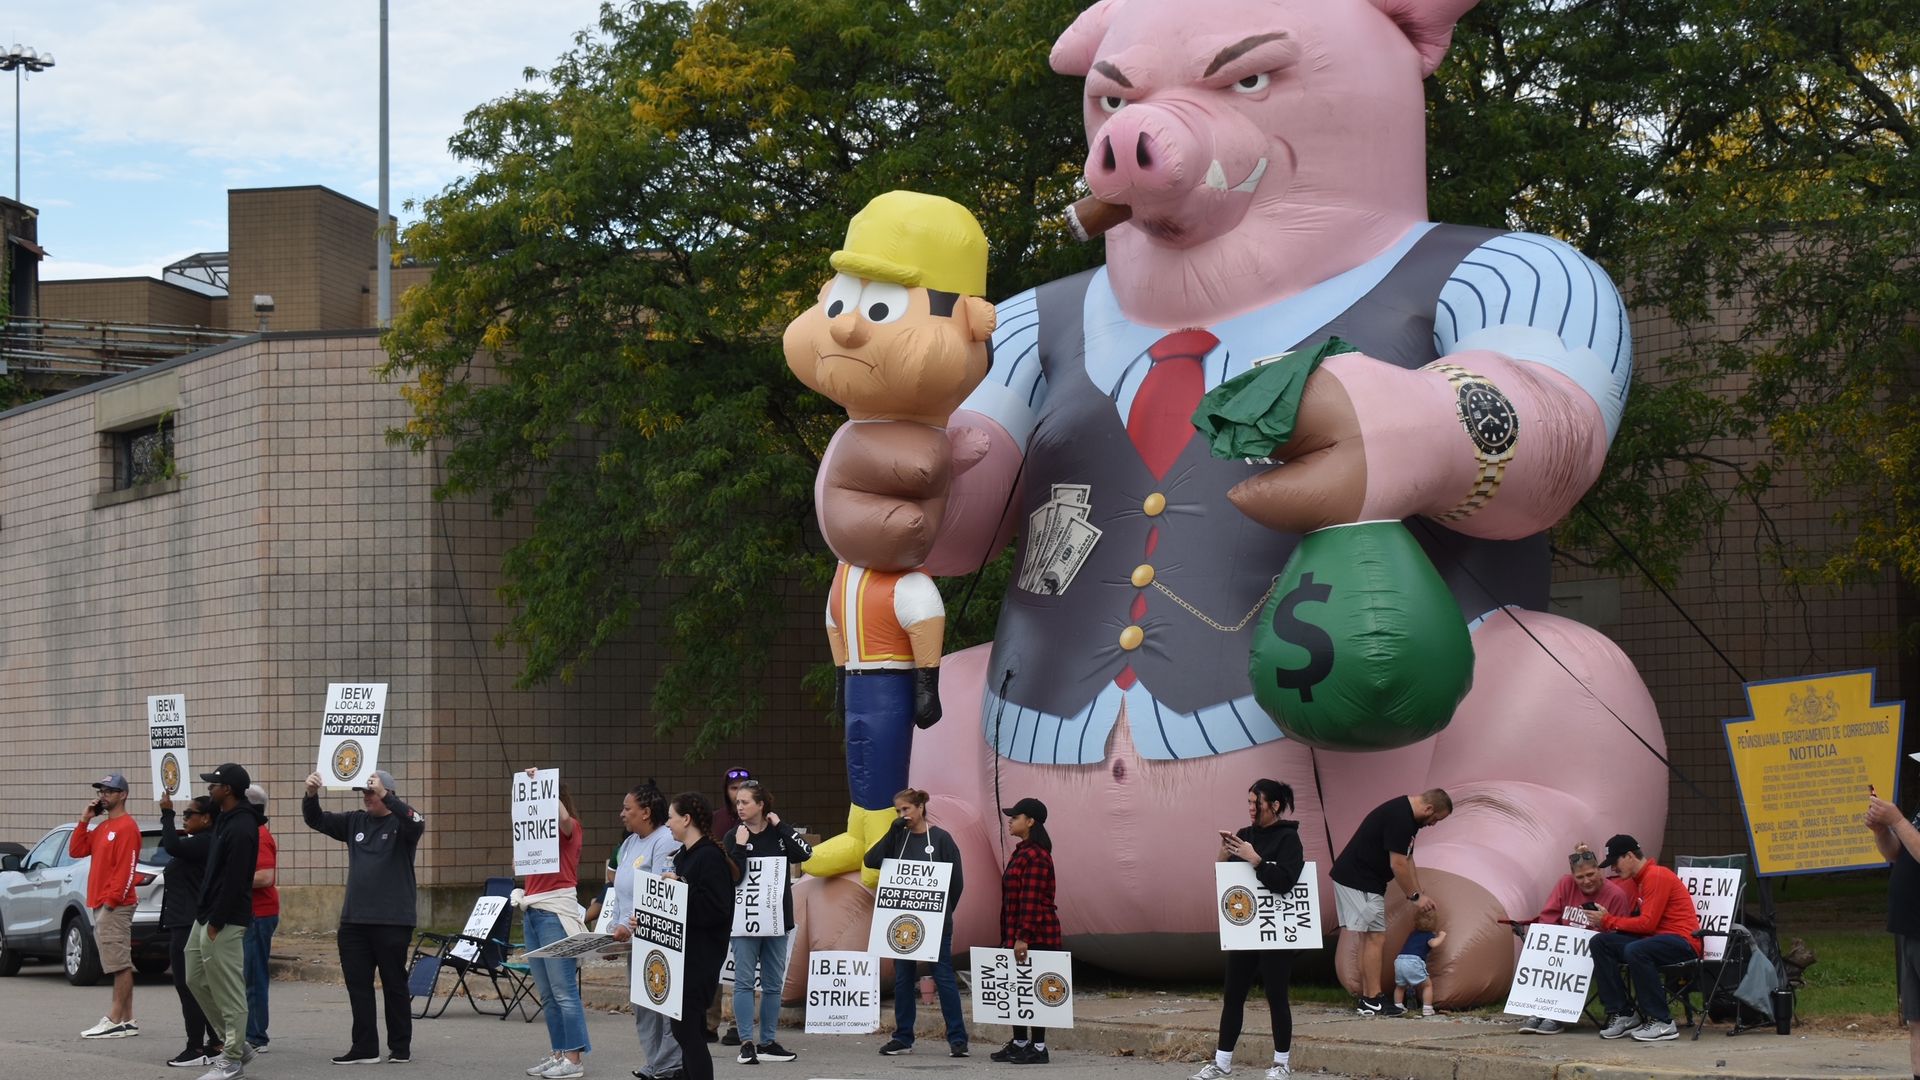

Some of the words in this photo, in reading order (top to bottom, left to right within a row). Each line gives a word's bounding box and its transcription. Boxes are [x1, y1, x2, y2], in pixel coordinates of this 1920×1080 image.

[340, 688, 373, 700] IBEW
[156, 699, 176, 712] IBEW
[335, 700, 364, 710] LOCAL
[366, 701, 376, 710] 29
[154, 713, 172, 722] LOCAL
[174, 713, 179, 722] 29
[326, 714, 344, 724] FOR
[345, 715, 378, 725] PEOPLE,
[152, 728, 162, 737] FOR
[325, 725, 342, 733] NOT
[343, 725, 378, 734] PROFITS!
[1782, 728, 1830, 744] DEPARTAMENTO
[1833, 726, 1840, 739] DE
[1843, 721, 1889, 738] CORRECCIONES
[152, 739, 162, 747] NOT
[163, 738, 184, 747] PROFITS!
[1789, 744, 1837, 760] NOTICIA
[514, 779, 556, 802] I.B.E.W.
[528, 805, 538, 816] ON
[514, 818, 556, 841] STRIKE
[896, 864, 935, 877] IBEW
[646, 878, 675, 900] IBEW
[890, 876, 924, 886] LOCAL
[927, 879, 938, 887] 29
[736, 889, 743, 905] ON
[746, 860, 762, 933] STRIKE
[880, 888, 900, 898] FOR
[902, 891, 943, 902] PEOPLE,
[641, 895, 668, 912] LOCAL
[670, 903, 678, 916] 29
[878, 899, 899, 907] NOT
[900, 900, 943, 910] PROFITS!
[1275, 899, 1281, 911] ON
[1281, 890, 1295, 921] CAL
[1294, 883, 1312, 929] IBEW
[1697, 900, 1710, 910] ON
[1257, 886, 1277, 942] TRIKE
[636, 912, 651, 925] FOR
[652, 916, 682, 936] PEOPLE,
[635, 926, 649, 938] NOT
[651, 930, 682, 949] PROFITS!
[1284, 926, 1298, 942] 29
[1526, 932, 1593, 958] I.B.E.W.
[811, 960, 871, 976] I.B.E.W.
[995, 954, 1008, 969] 29
[1548, 956, 1563, 967] ON
[833, 978, 846, 987] ON
[981, 965, 996, 1005] IBEW
[1010, 982, 1016, 992] ON
[1016, 957, 1034, 1019] STRIKE
[1517, 967, 1588, 994] STRIKE
[809, 991, 870, 1007] STRIKE
[996, 974, 1010, 1018] LOCAL
[1535, 997, 1558, 1005] AGAINST
[1508, 1001, 1538, 1009] DUQUESNE
[1554, 1007, 1580, 1016] COMPANY
